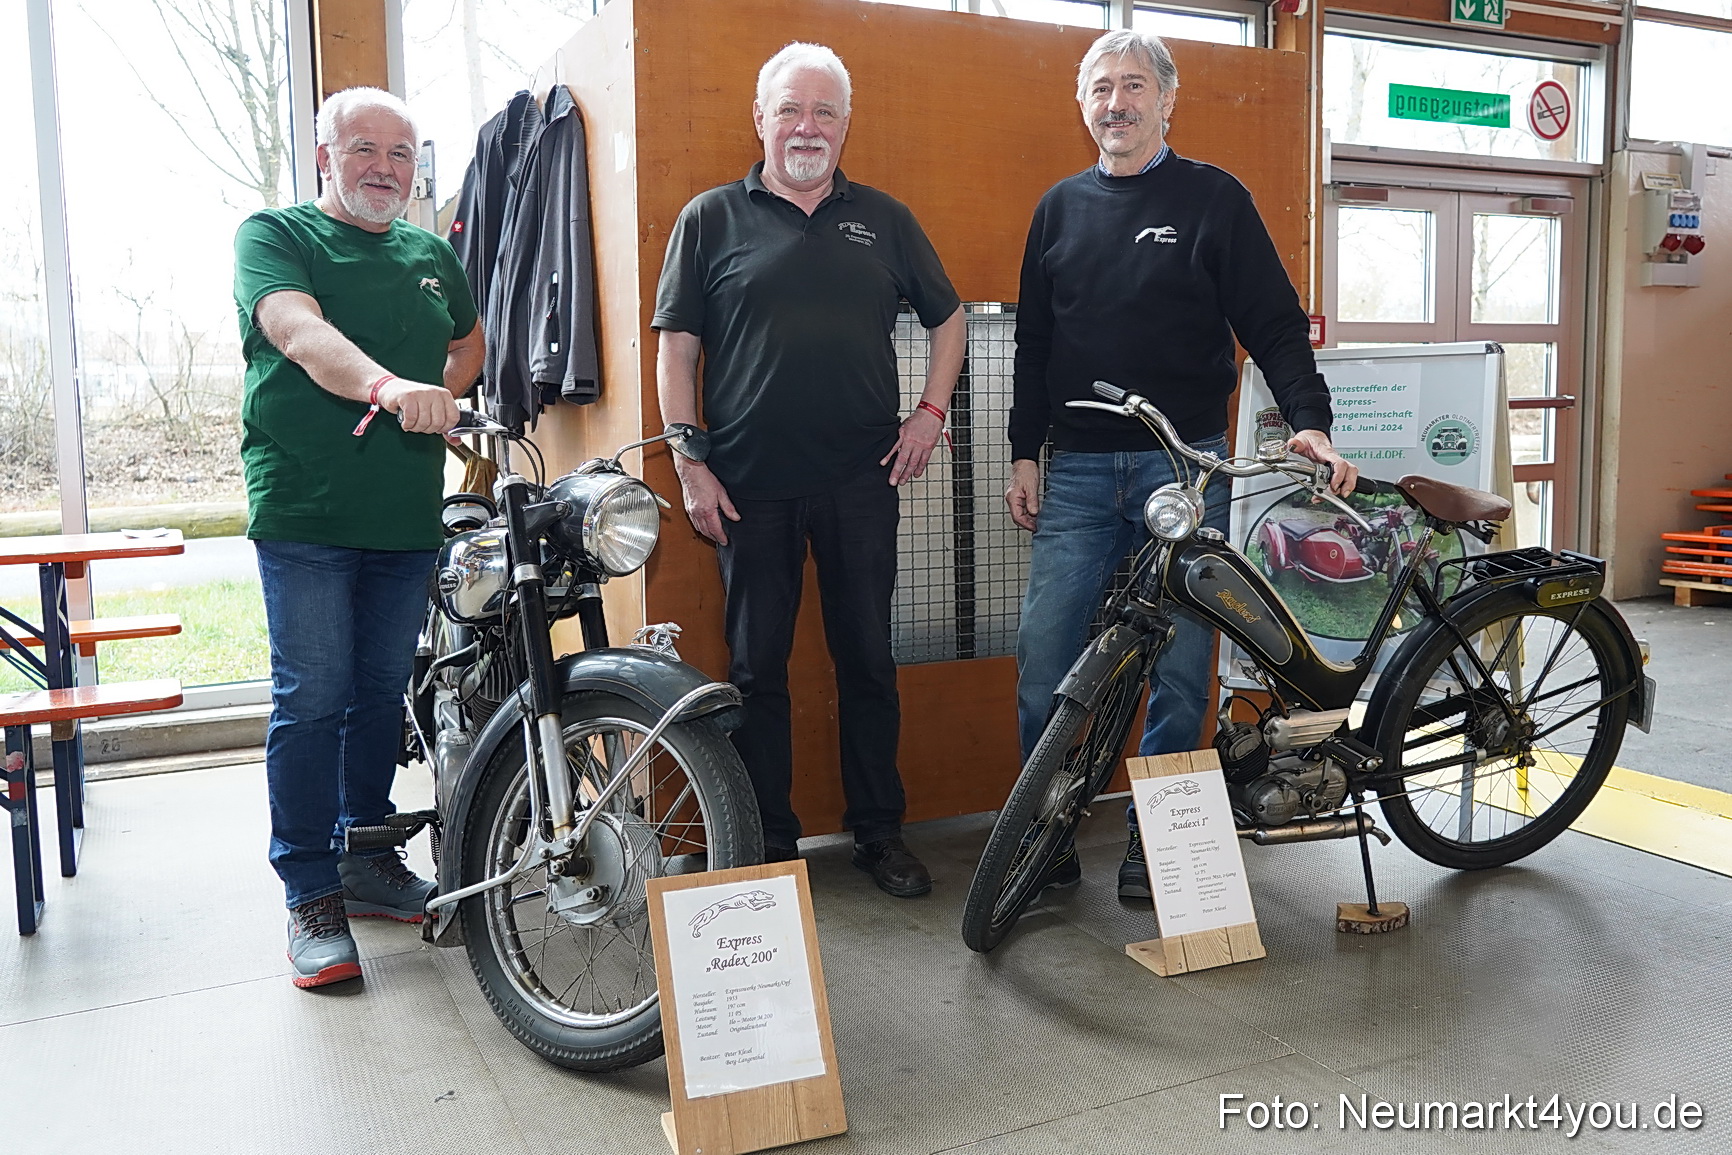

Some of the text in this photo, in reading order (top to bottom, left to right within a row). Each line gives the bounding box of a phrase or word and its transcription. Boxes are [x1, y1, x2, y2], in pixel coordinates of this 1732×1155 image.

[1329, 384, 1407, 393] ahrestreffen der
[1336, 398, 1377, 407] Express-
[1333, 410, 1413, 420] sengemeinschaft
[1331, 424, 1403, 432] is 16. Juni 2024
[1421, 414, 1450, 442] NEUMARKTER
[1451, 413, 1480, 455] OLDTIMERTREFFEN
[1339, 450, 1367, 459] markt
[1550, 587, 1590, 600] EXPRESS
[1169, 806, 1201, 818] Express
[716, 933, 763, 951] Express
[705, 947, 778, 973] „Radex 200“
[741, 1015, 756, 1023] Motor
[724, 1050, 737, 1058] Peter
